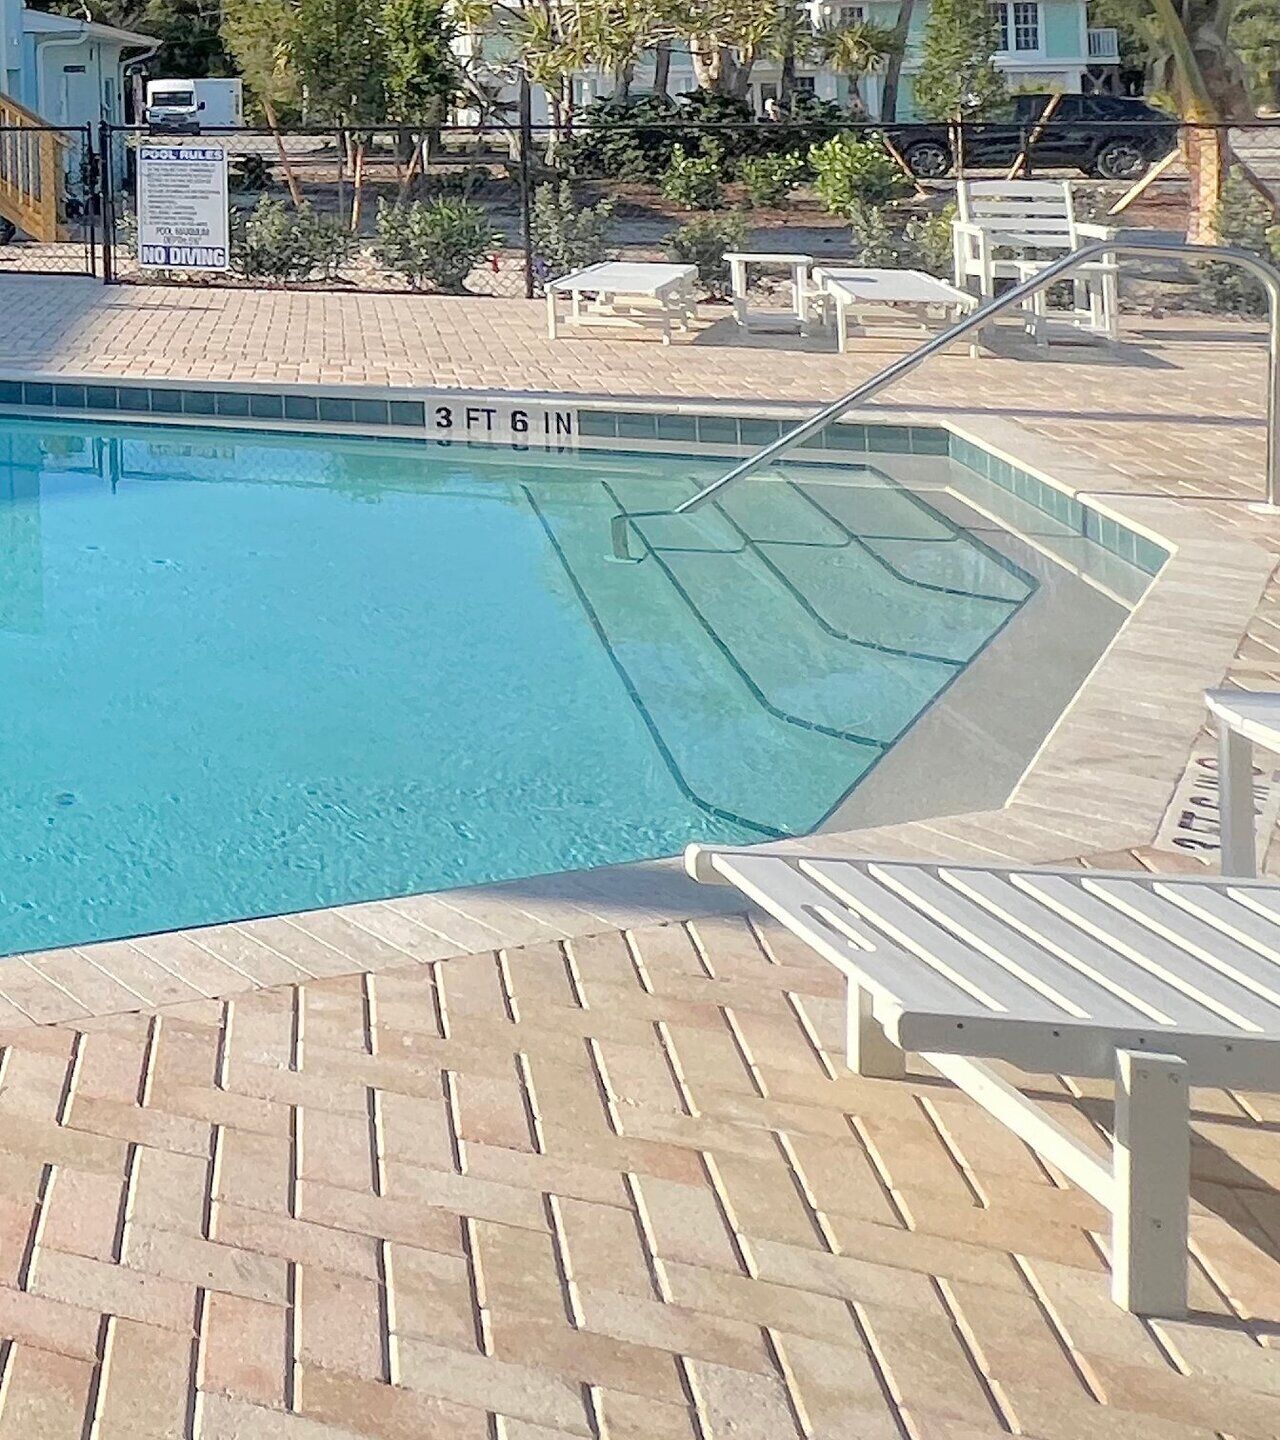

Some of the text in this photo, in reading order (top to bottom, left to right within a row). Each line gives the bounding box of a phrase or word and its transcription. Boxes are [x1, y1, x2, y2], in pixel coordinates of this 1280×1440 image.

[142, 149, 223, 160] POOL RULES
[143, 246, 225, 266] NO DIVING
[435, 406, 572, 435] 3 FT 6 IN
